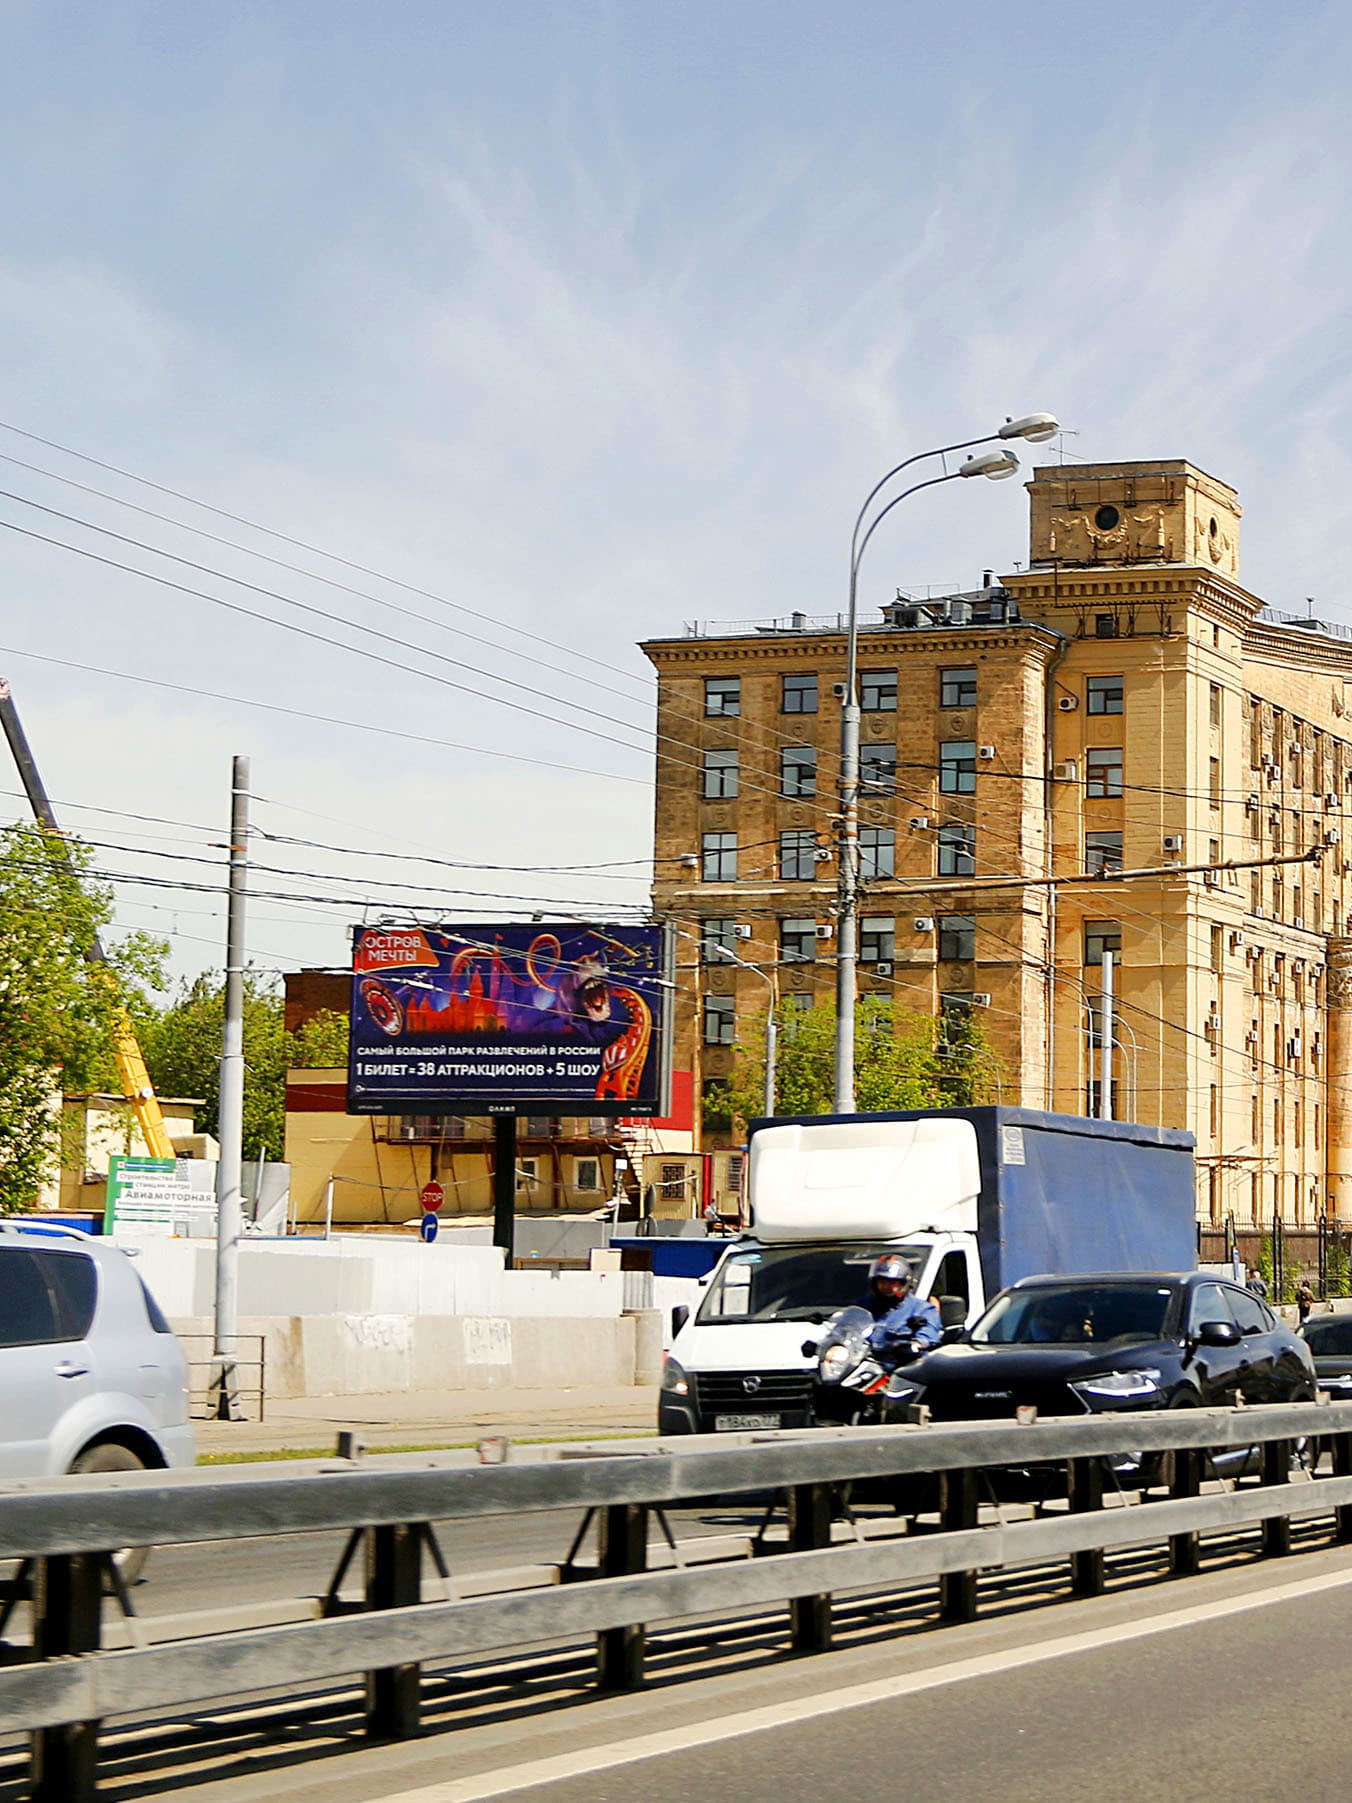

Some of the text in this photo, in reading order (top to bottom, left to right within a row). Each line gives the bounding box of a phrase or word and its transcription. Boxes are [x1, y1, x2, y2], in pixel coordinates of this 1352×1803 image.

[365, 936, 421, 948] ОСТРОВ
[368, 950, 417, 961] МЕЧТЫ
[357, 1045, 601, 1055] САМЫЙ БОЛЬШОЙ ПАРК РАЗВЛЕЧЕНИЙ В РОССИИ
[356, 1063, 363, 1075] 1
[364, 1064, 408, 1075] БИЛЕТ
[417, 1062, 436, 1075] 38
[437, 1064, 545, 1077] АТТРАКЦИОНОВ
[556, 1062, 566, 1075] 5
[567, 1064, 600, 1075] ШОУ
[125, 1190, 212, 1202] Авиамоторная
[422, 1192, 443, 1201] STOP
